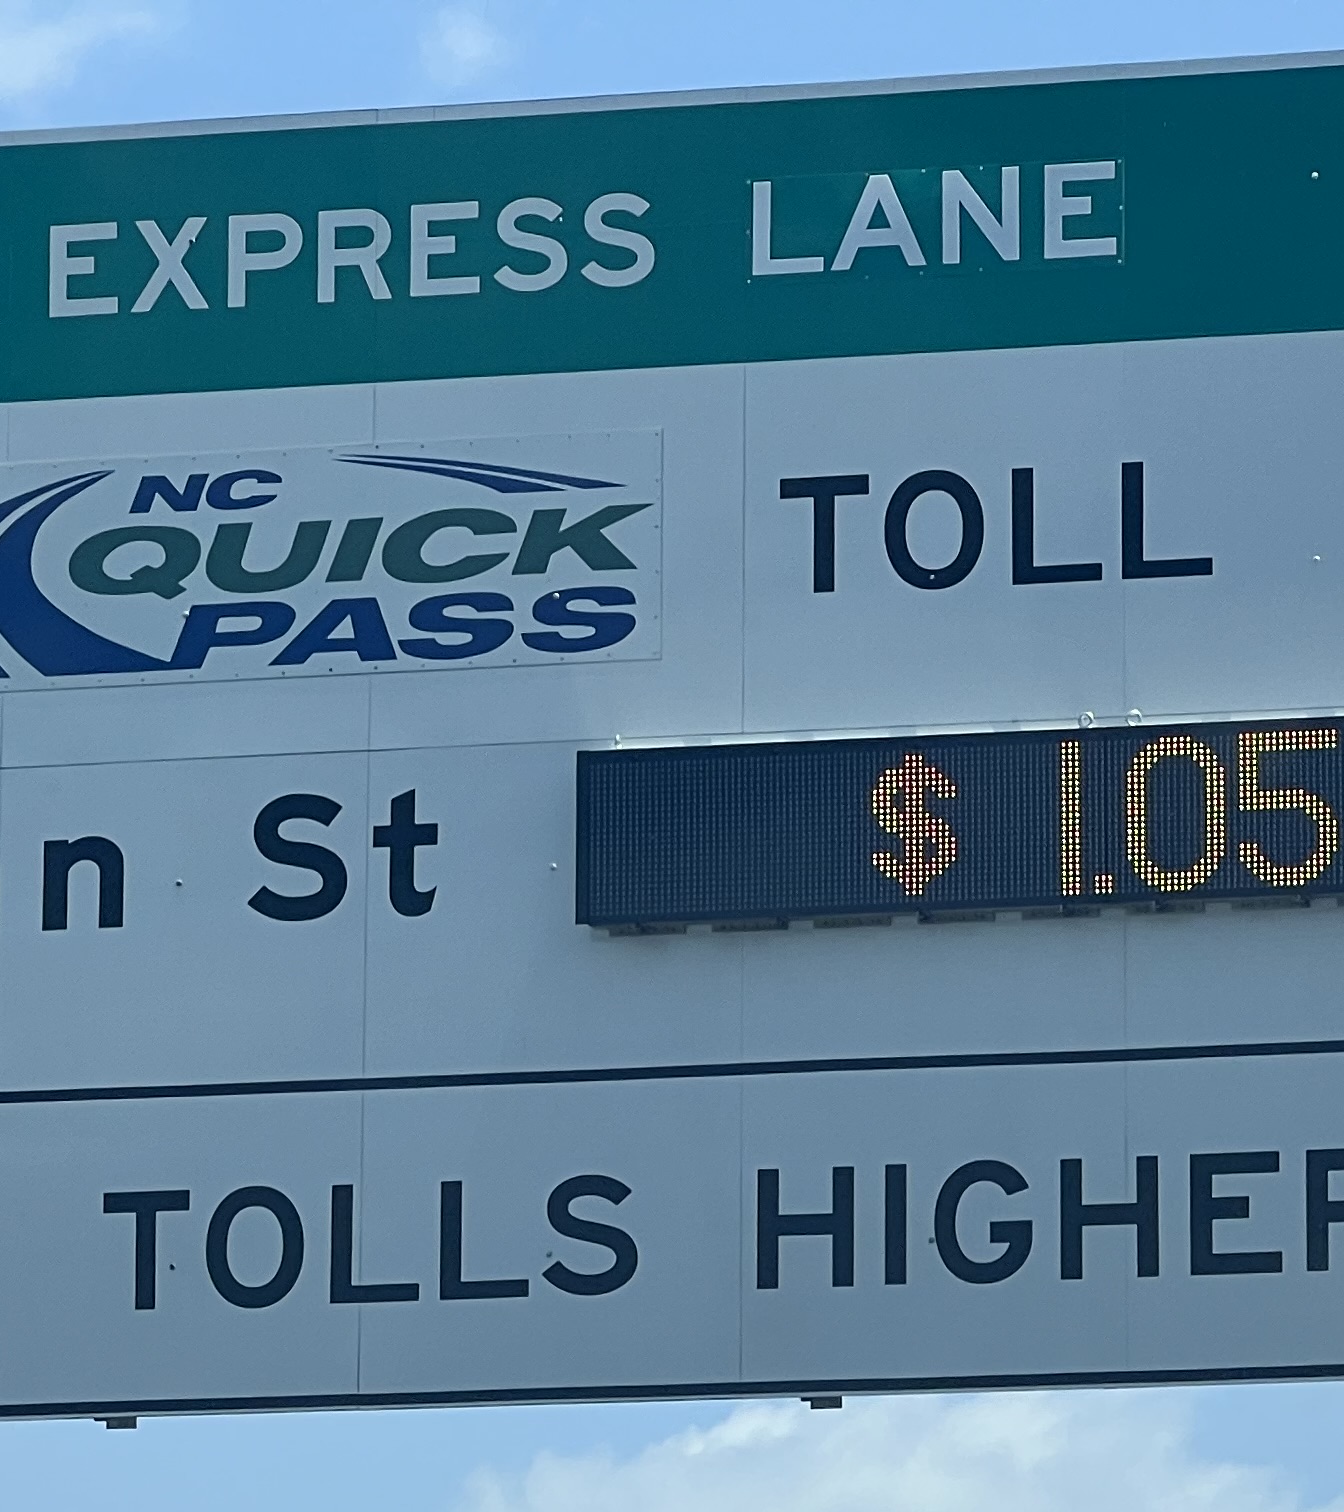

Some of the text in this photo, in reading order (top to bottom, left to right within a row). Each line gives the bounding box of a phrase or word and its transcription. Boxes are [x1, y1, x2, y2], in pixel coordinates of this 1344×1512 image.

[47, 159, 1120, 319] EXPRESS LANE
[67, 502, 655, 600] QUICK
[129, 469, 283, 515] NC
[779, 460, 1214, 594] TOLL
[169, 586, 638, 670] PASS
[246, 787, 440, 922] St
[1060, 728, 1341, 897] 1.05
[102, 1173, 640, 1312] TOLLS
